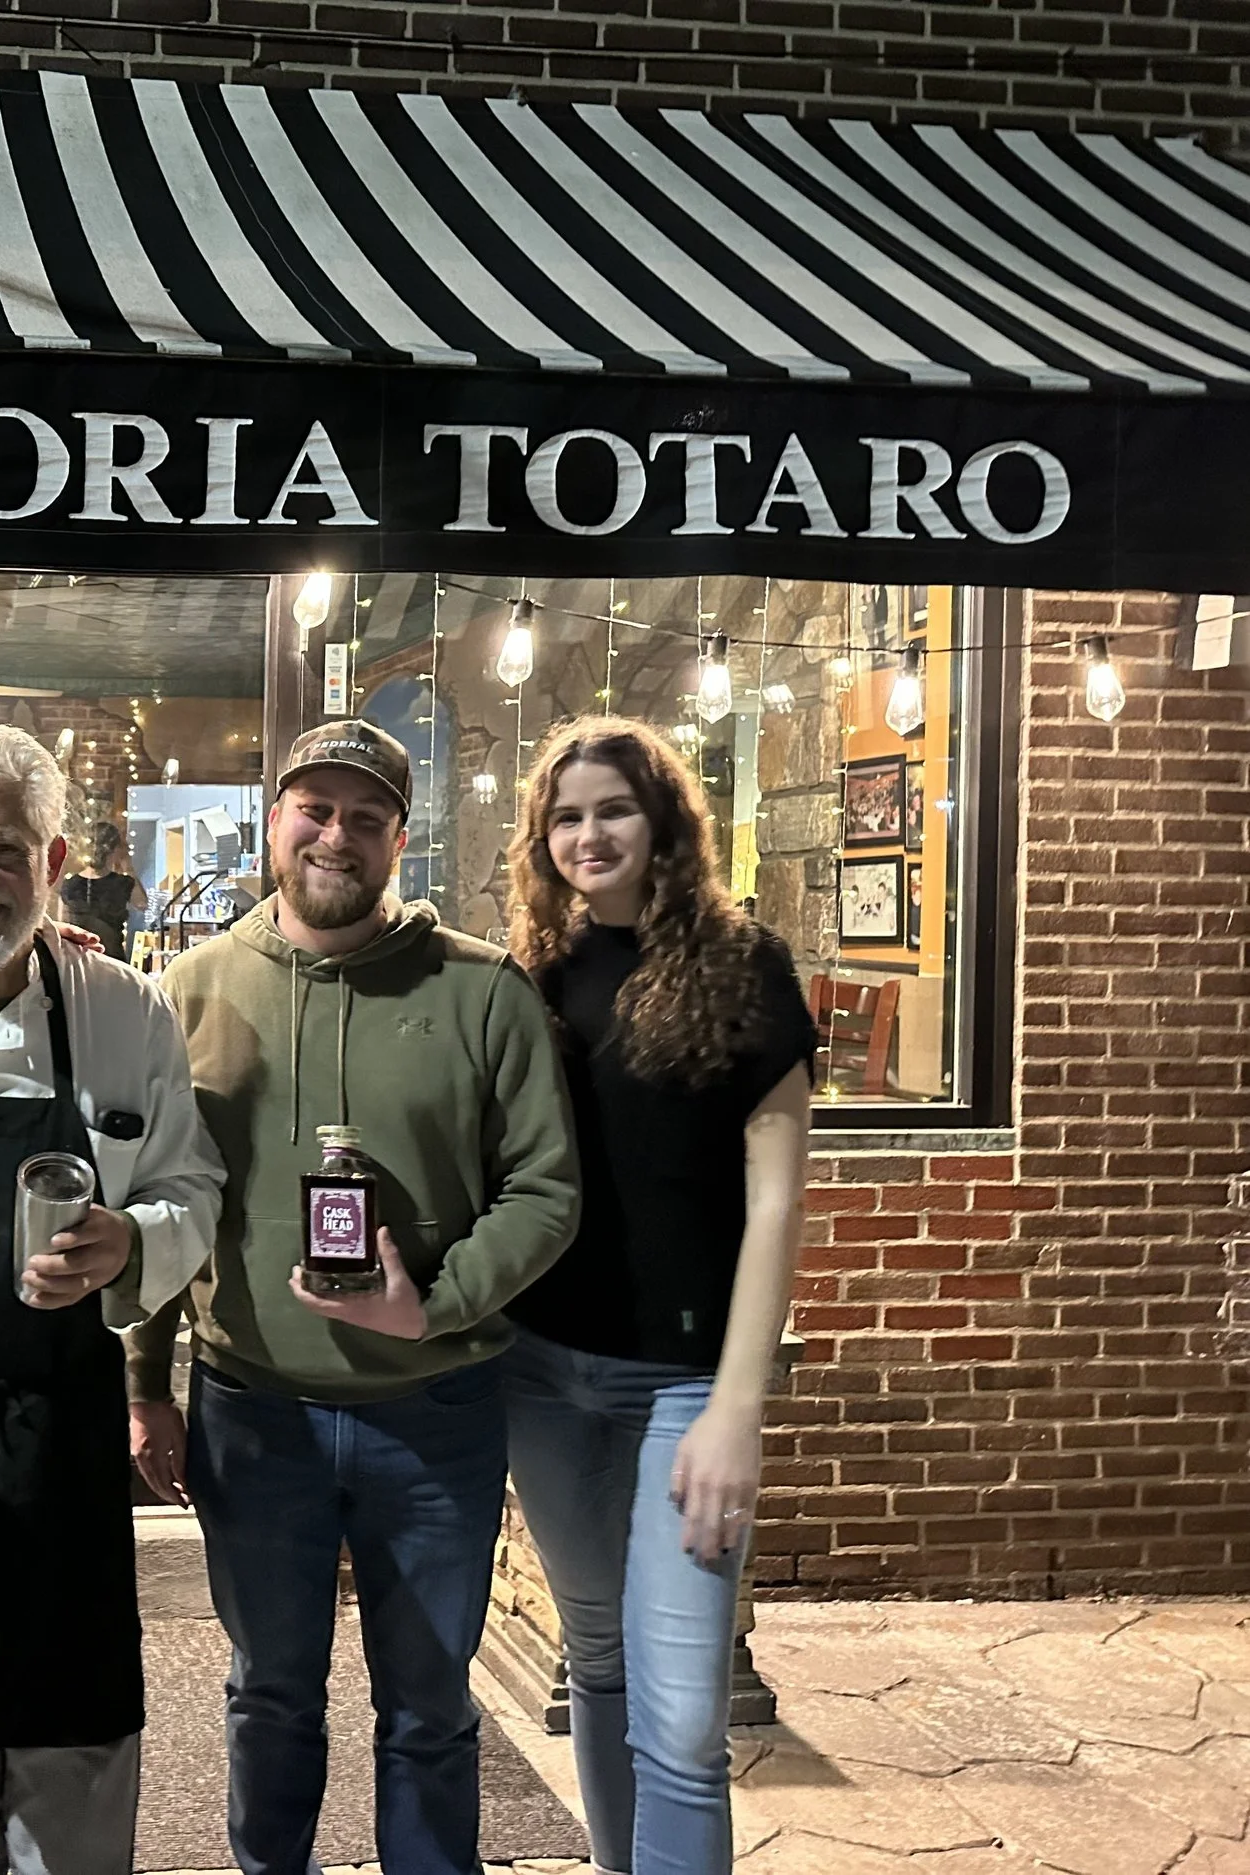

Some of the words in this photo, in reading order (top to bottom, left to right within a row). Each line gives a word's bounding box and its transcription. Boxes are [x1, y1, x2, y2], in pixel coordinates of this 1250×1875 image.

[424, 425, 1071, 544] TOTARO
[313, 740, 374, 754] FEDERAL
[322, 1206, 351, 1219] CASK
[322, 1218, 354, 1231] HEAD
